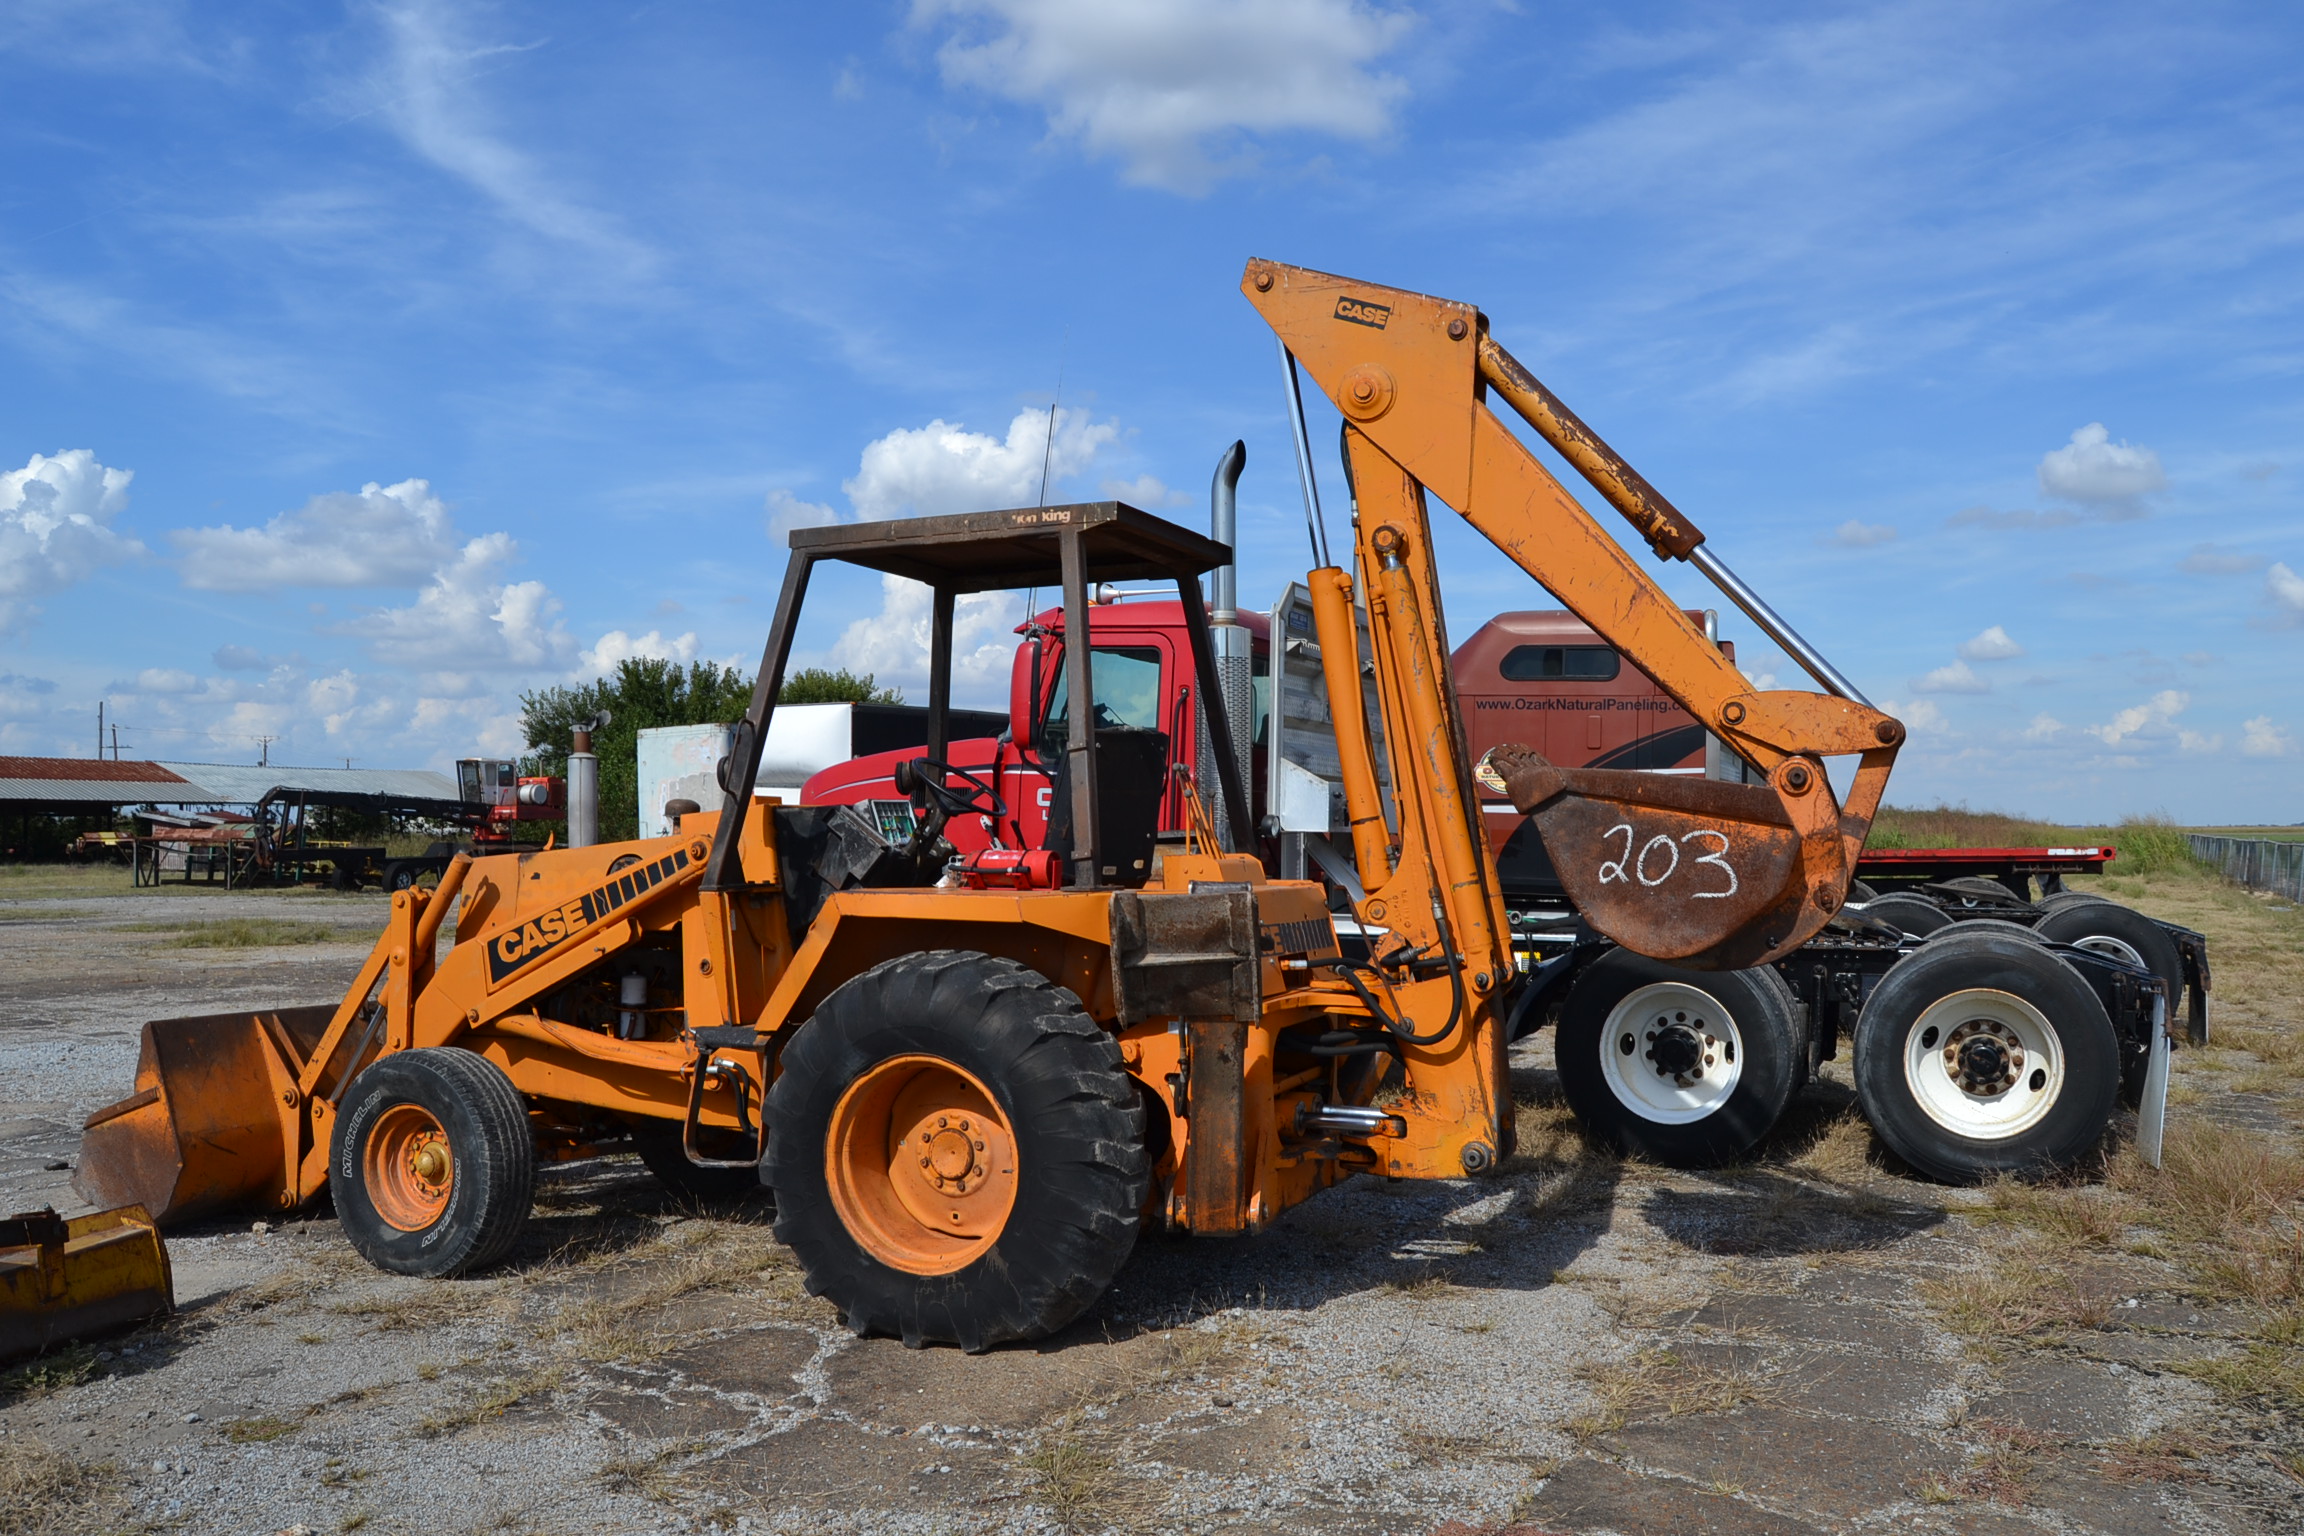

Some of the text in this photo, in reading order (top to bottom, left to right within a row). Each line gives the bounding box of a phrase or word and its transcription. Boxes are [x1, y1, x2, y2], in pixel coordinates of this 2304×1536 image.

[1337, 301, 1390, 326] CASE
[1476, 697, 1681, 713] www.OzarkNaturalPaneling.c
[1598, 823, 1739, 899] 203
[496, 898, 589, 963] CASE
[342, 1089, 382, 1178] MICHELIN
[421, 1157, 461, 1248] MICHELIN
